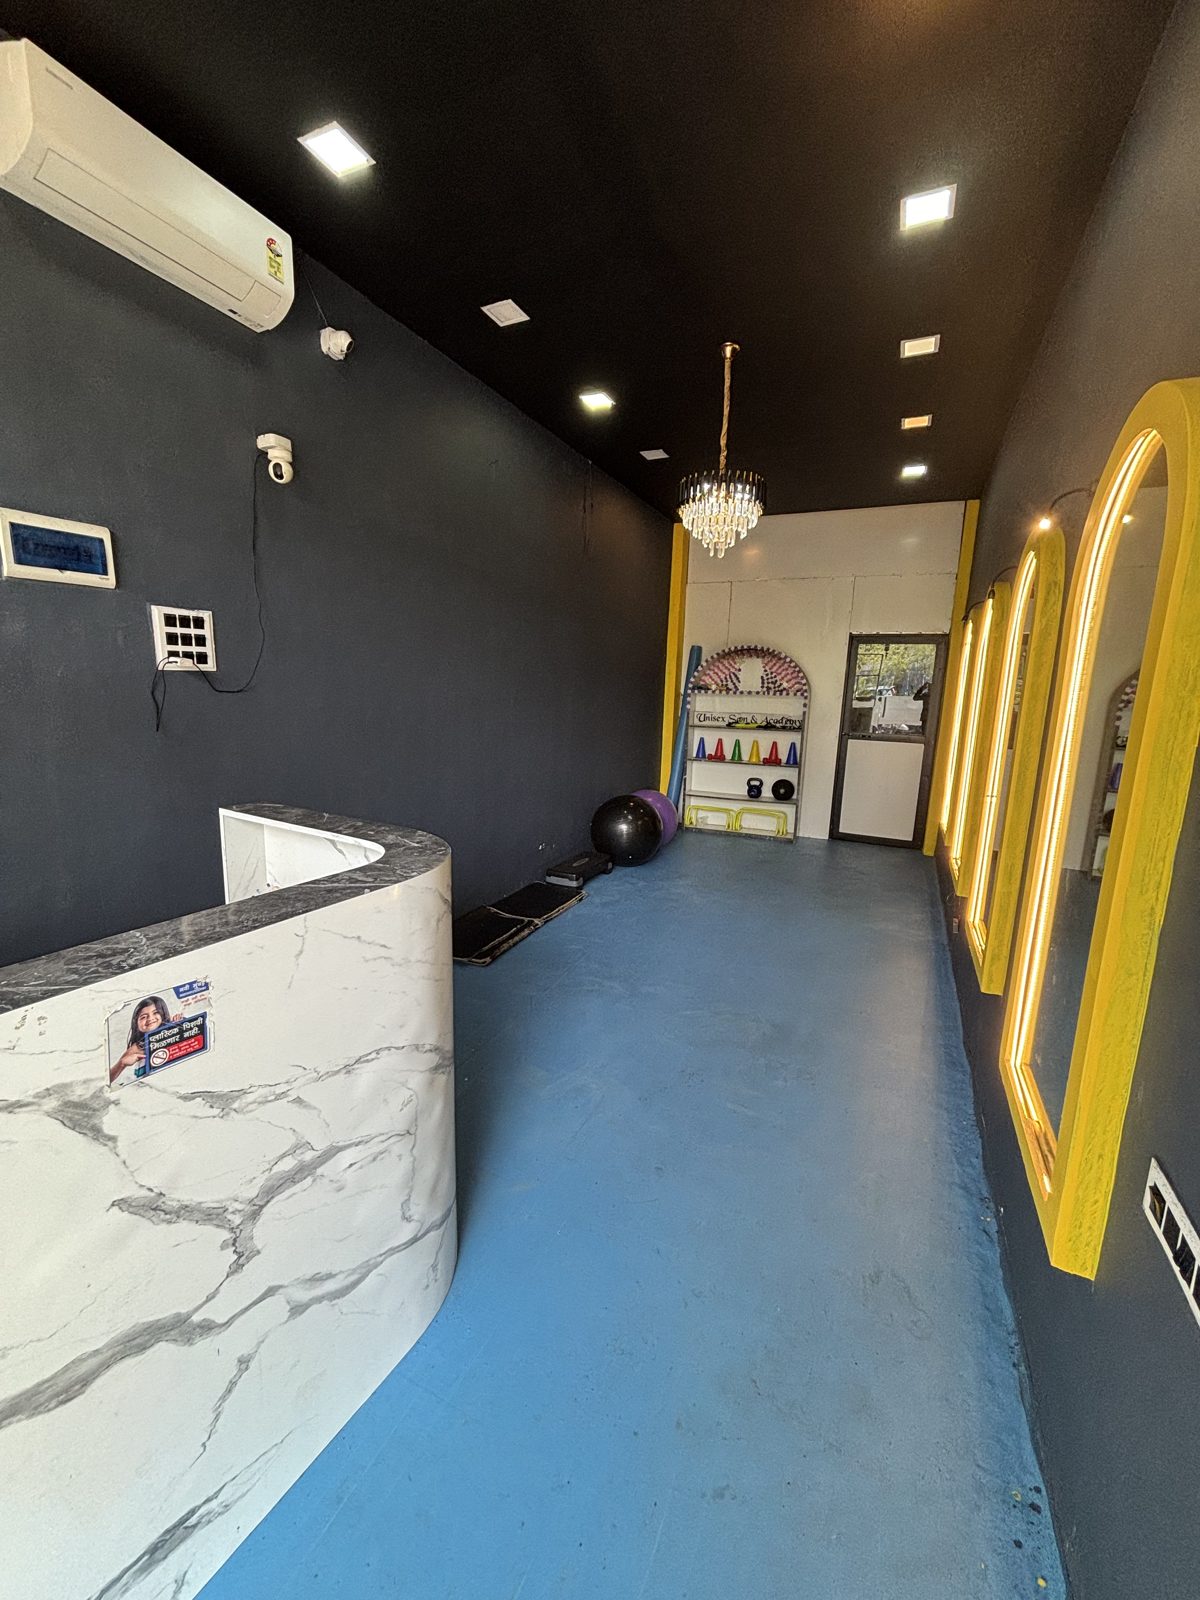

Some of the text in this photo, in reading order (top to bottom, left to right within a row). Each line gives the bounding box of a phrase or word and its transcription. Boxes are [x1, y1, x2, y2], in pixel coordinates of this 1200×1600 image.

[696, 712, 726, 723] Unisex
[750, 714, 758, 724] &
[760, 715, 802, 727] Academy
